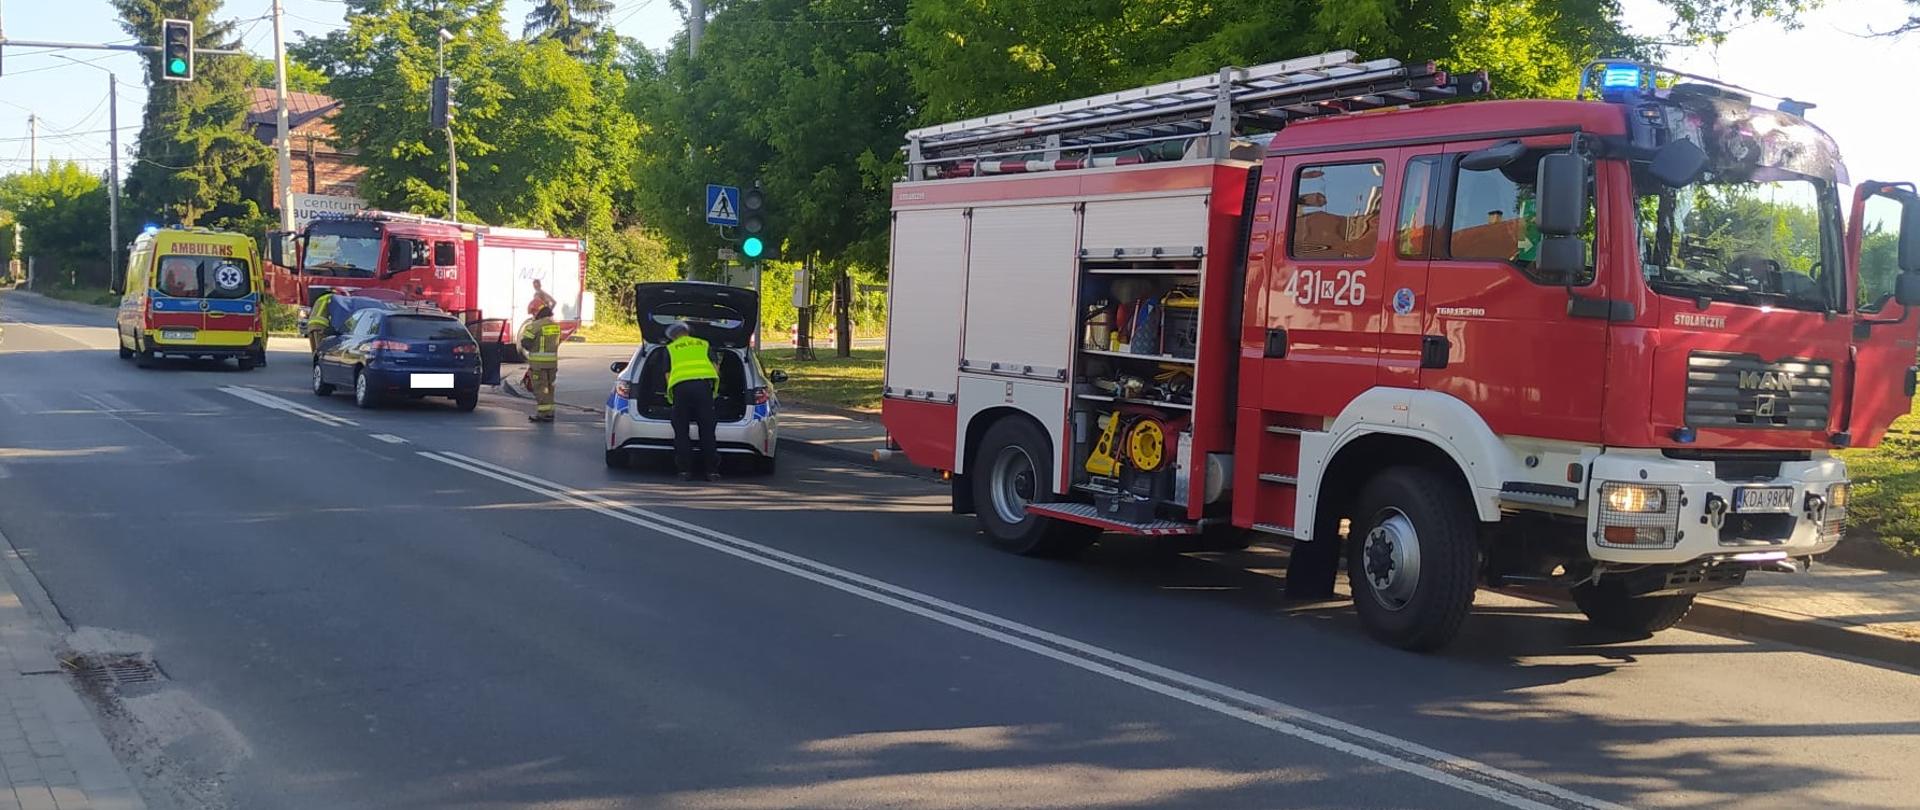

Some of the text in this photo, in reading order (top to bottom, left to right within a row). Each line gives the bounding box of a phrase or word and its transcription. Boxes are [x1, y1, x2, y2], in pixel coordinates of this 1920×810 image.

[303, 199, 361, 210] centrum
[170, 242, 233, 256] AMBULANS
[1674, 313, 1726, 329] STOLARCZYK
[1739, 369, 1794, 391] MAN
[1744, 487, 1794, 508] KDA 98KM
